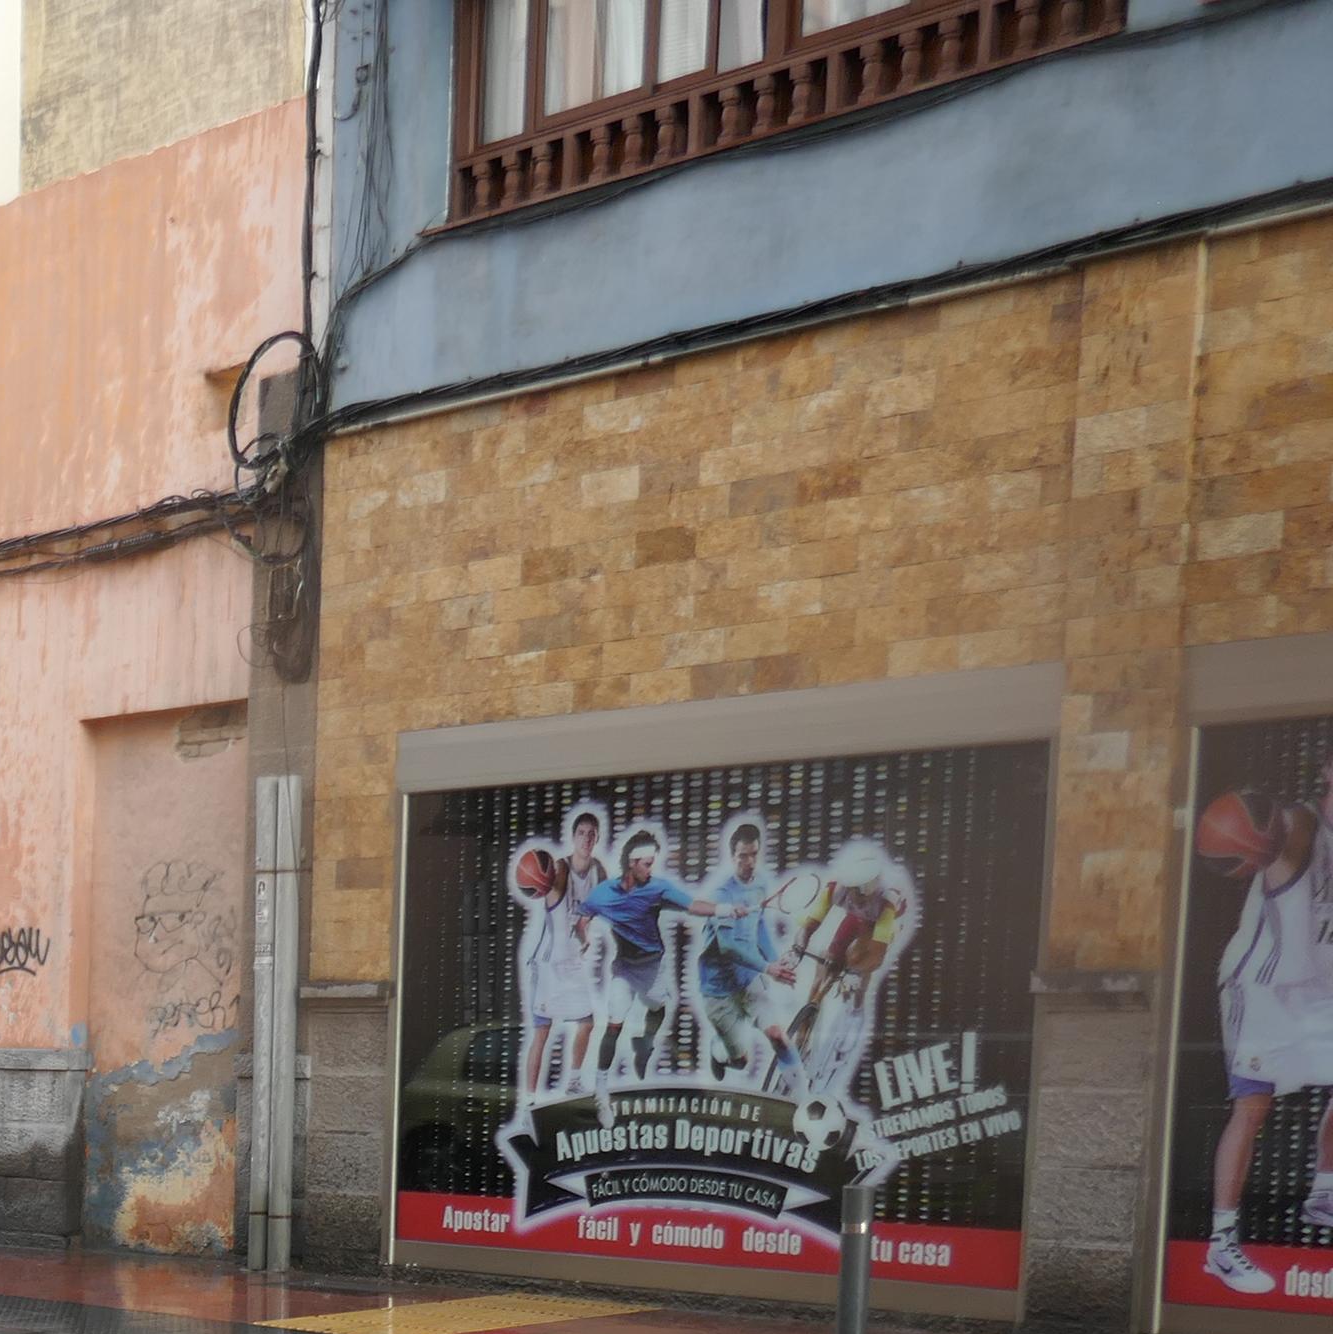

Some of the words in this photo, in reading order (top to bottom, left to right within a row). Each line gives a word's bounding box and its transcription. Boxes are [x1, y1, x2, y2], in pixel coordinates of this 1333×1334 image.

[874, 1031, 977, 1112] LIVE!
[611, 1096, 732, 1118] TRAMITACIÓN
[739, 1104, 762, 1122] DE
[555, 1122, 669, 1162] Apuestas
[674, 1118, 822, 1174] Deportivas
[633, 1172, 688, 1194] CÓMODO
[689, 1178, 727, 1197] DESDE
[727, 1182, 742, 1200] TU
[442, 1204, 511, 1233] Apostar
[577, 1215, 619, 1242] fácil
[629, 1221, 641, 1246] y
[651, 1220, 724, 1250] cómodo
[741, 1226, 803, 1256] desde
[870, 1233, 893, 1263] tu
[897, 1240, 952, 1268] casa
